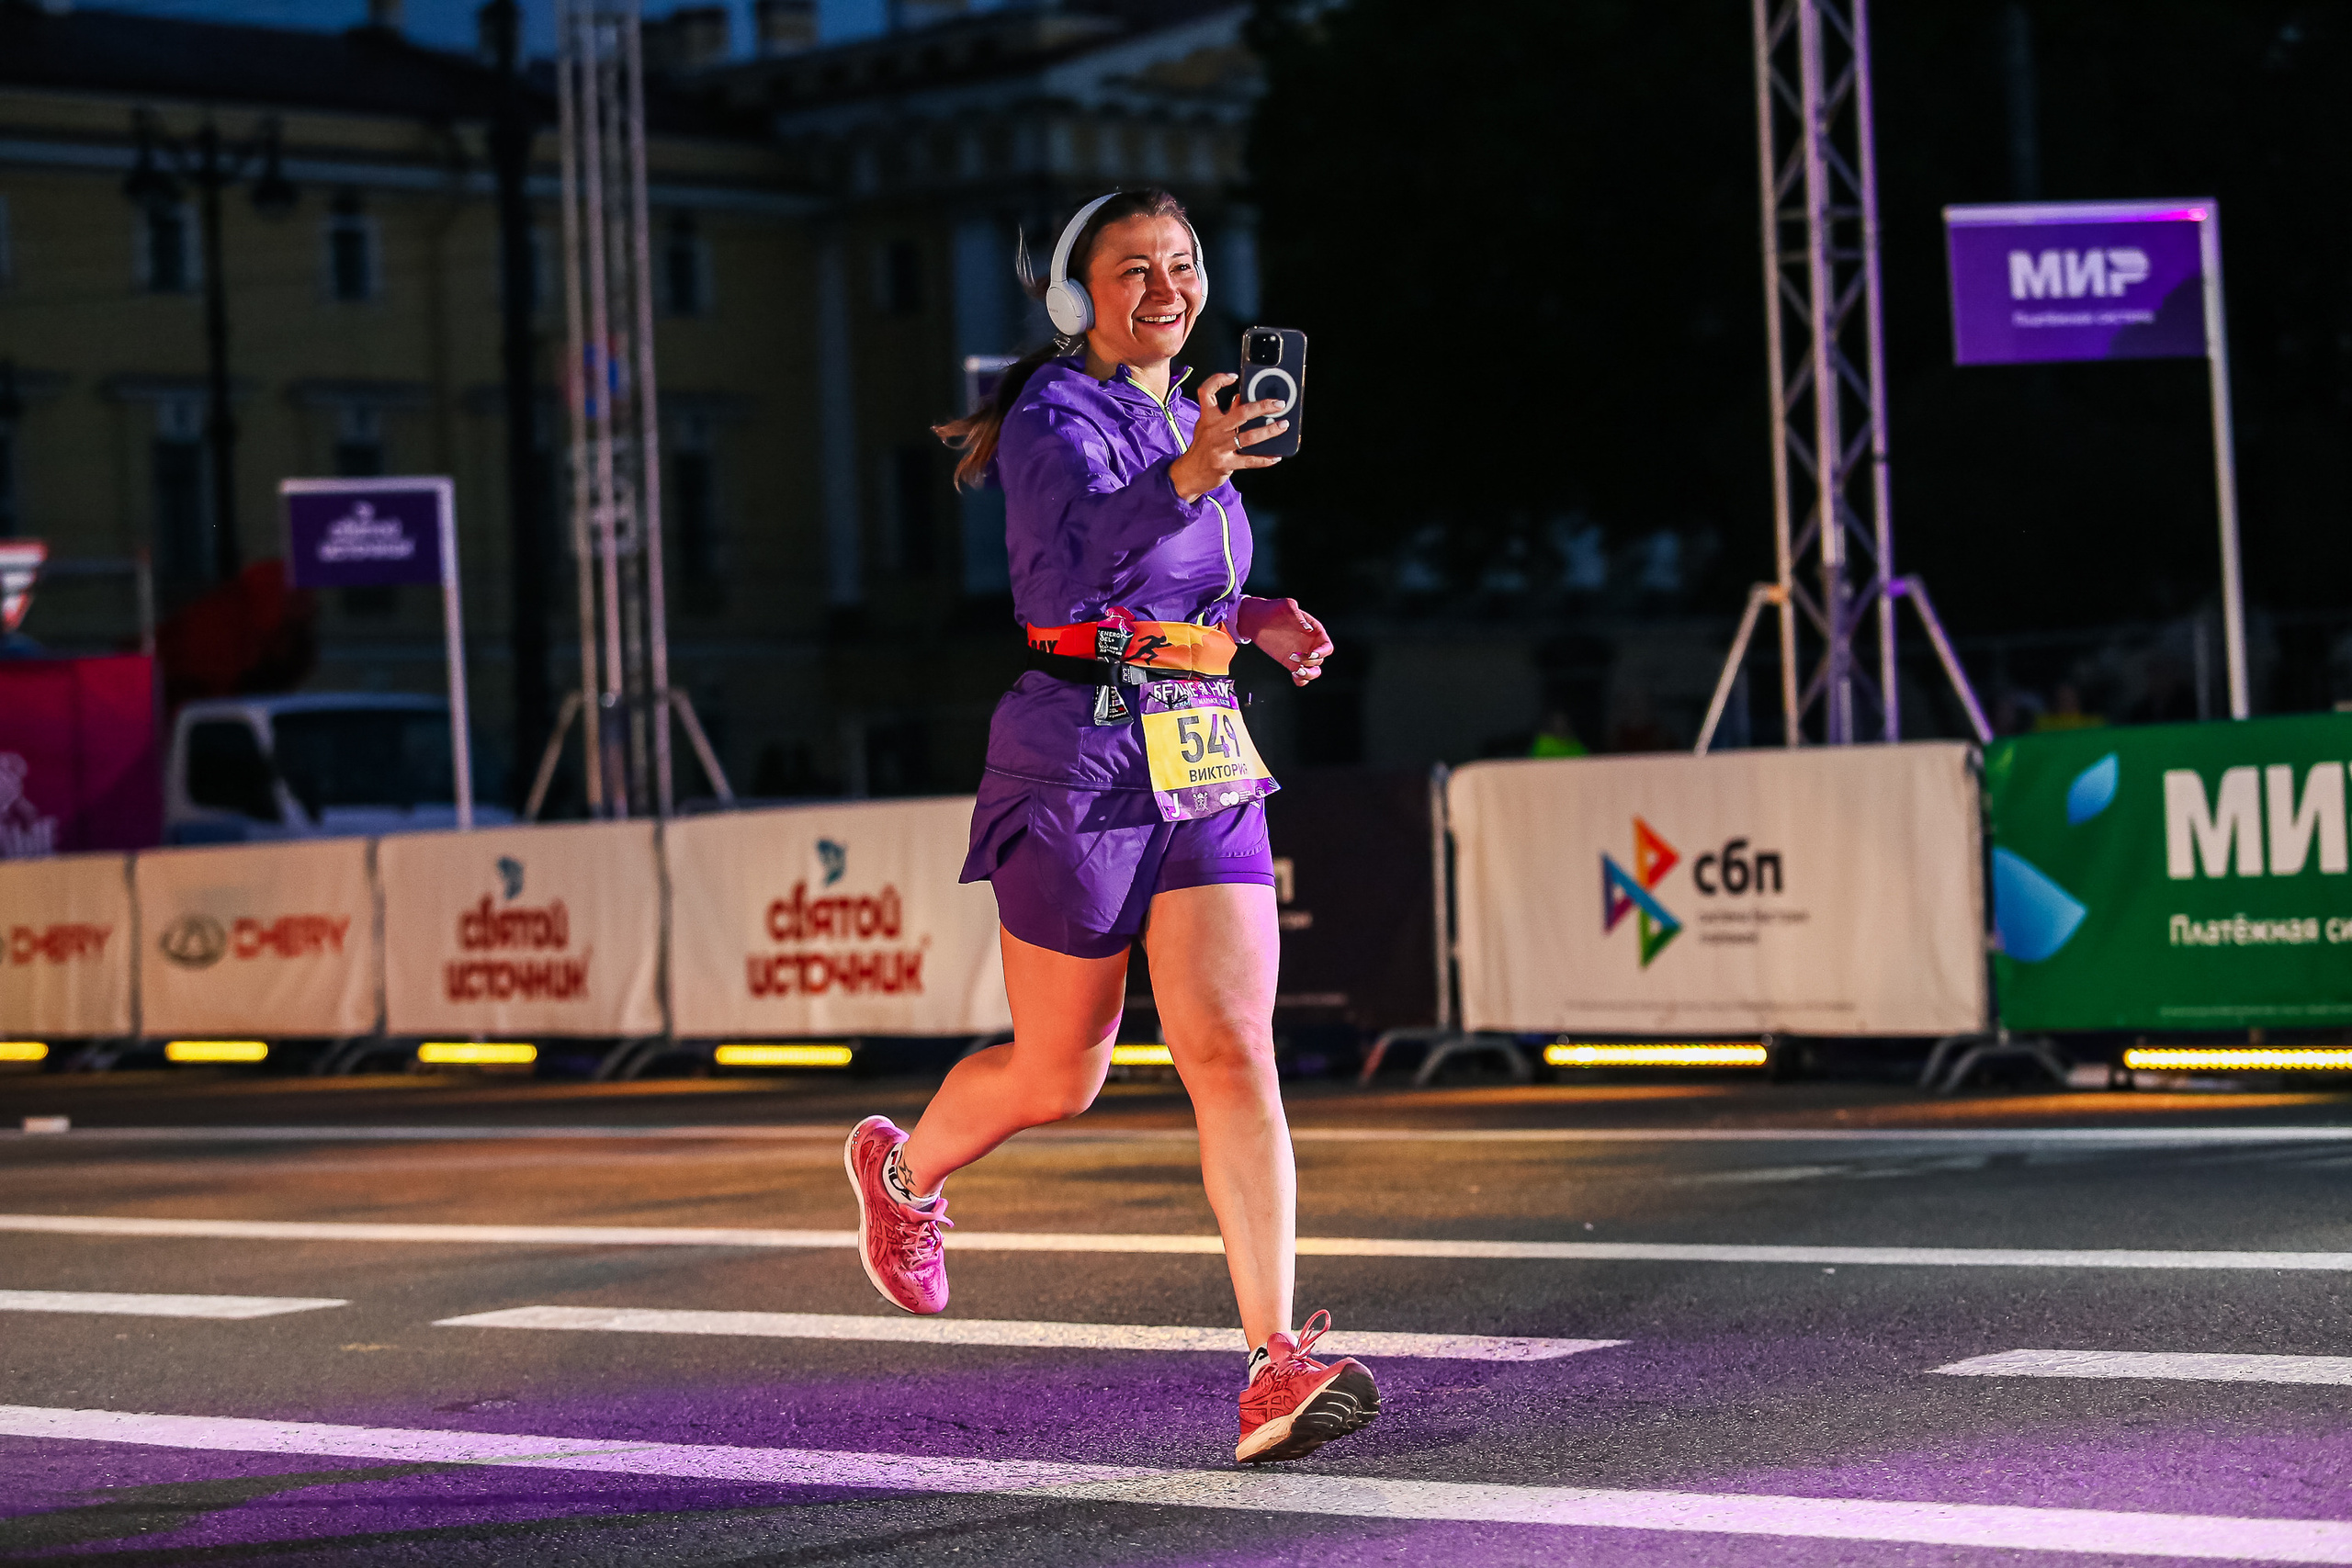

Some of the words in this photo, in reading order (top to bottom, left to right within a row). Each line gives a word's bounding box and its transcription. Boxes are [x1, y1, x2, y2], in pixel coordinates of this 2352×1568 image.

[2008, 247, 2152, 300] МИР
[2163, 761, 2352, 880] МИ
[1692, 835, 1783, 896] сбп
